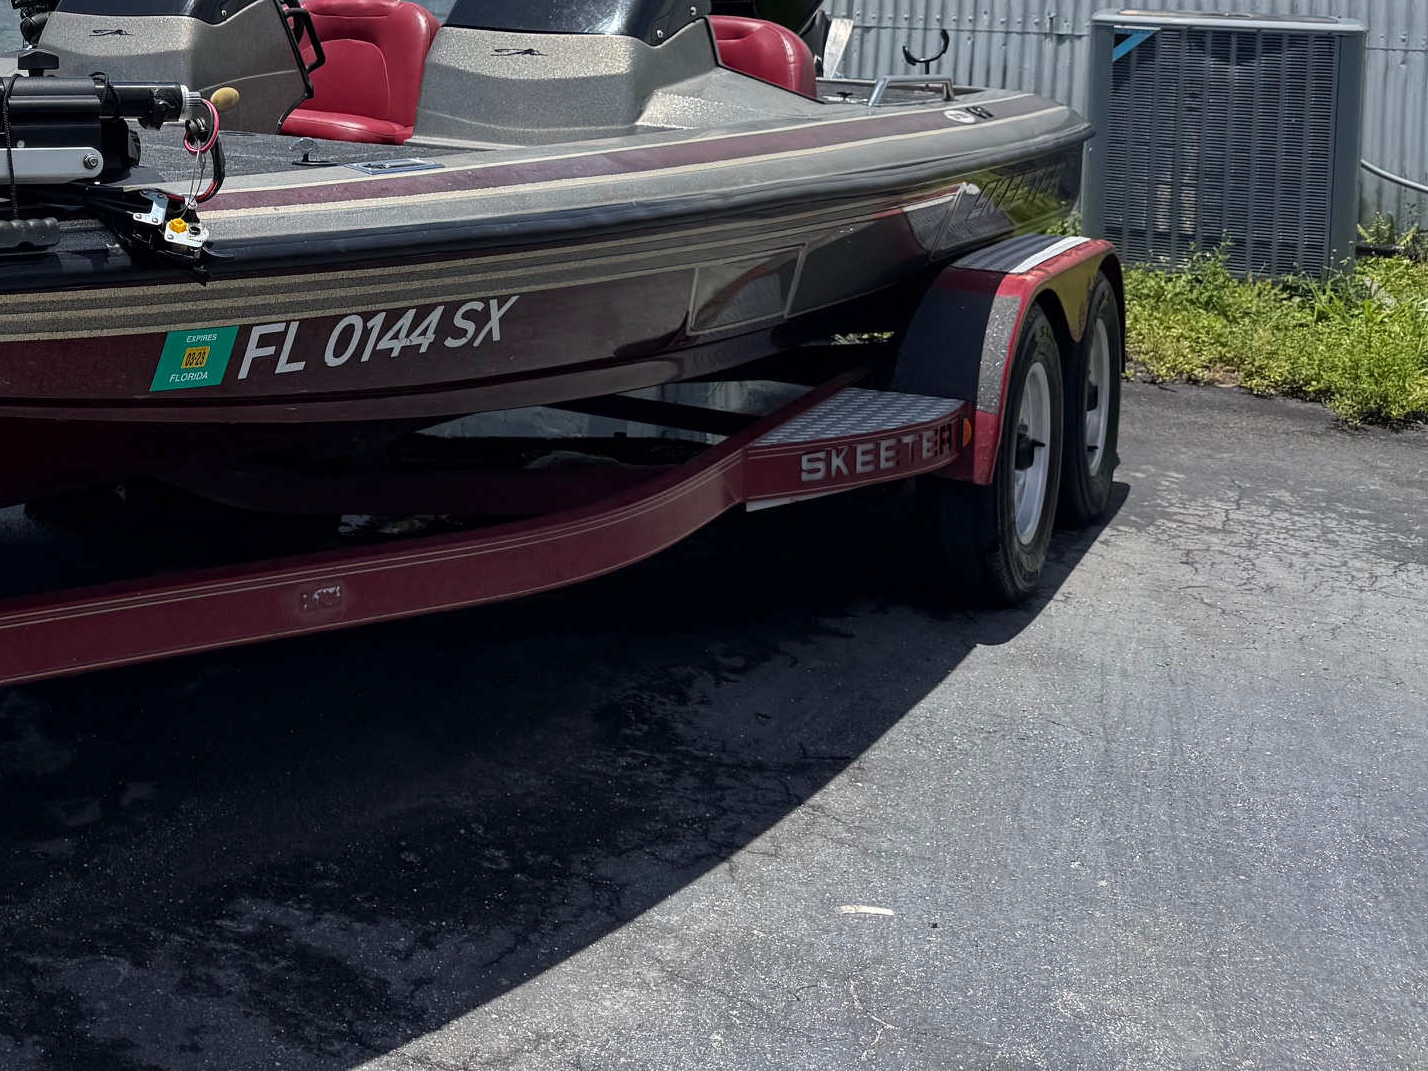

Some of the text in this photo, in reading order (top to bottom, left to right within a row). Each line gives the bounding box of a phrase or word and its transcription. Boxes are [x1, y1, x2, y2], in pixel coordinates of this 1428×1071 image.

[186, 333, 218, 343] EXPIRES
[237, 295, 521, 380] FL 0144 SX
[169, 371, 209, 383] FLORIDA
[800, 423, 953, 483] SKEETER
